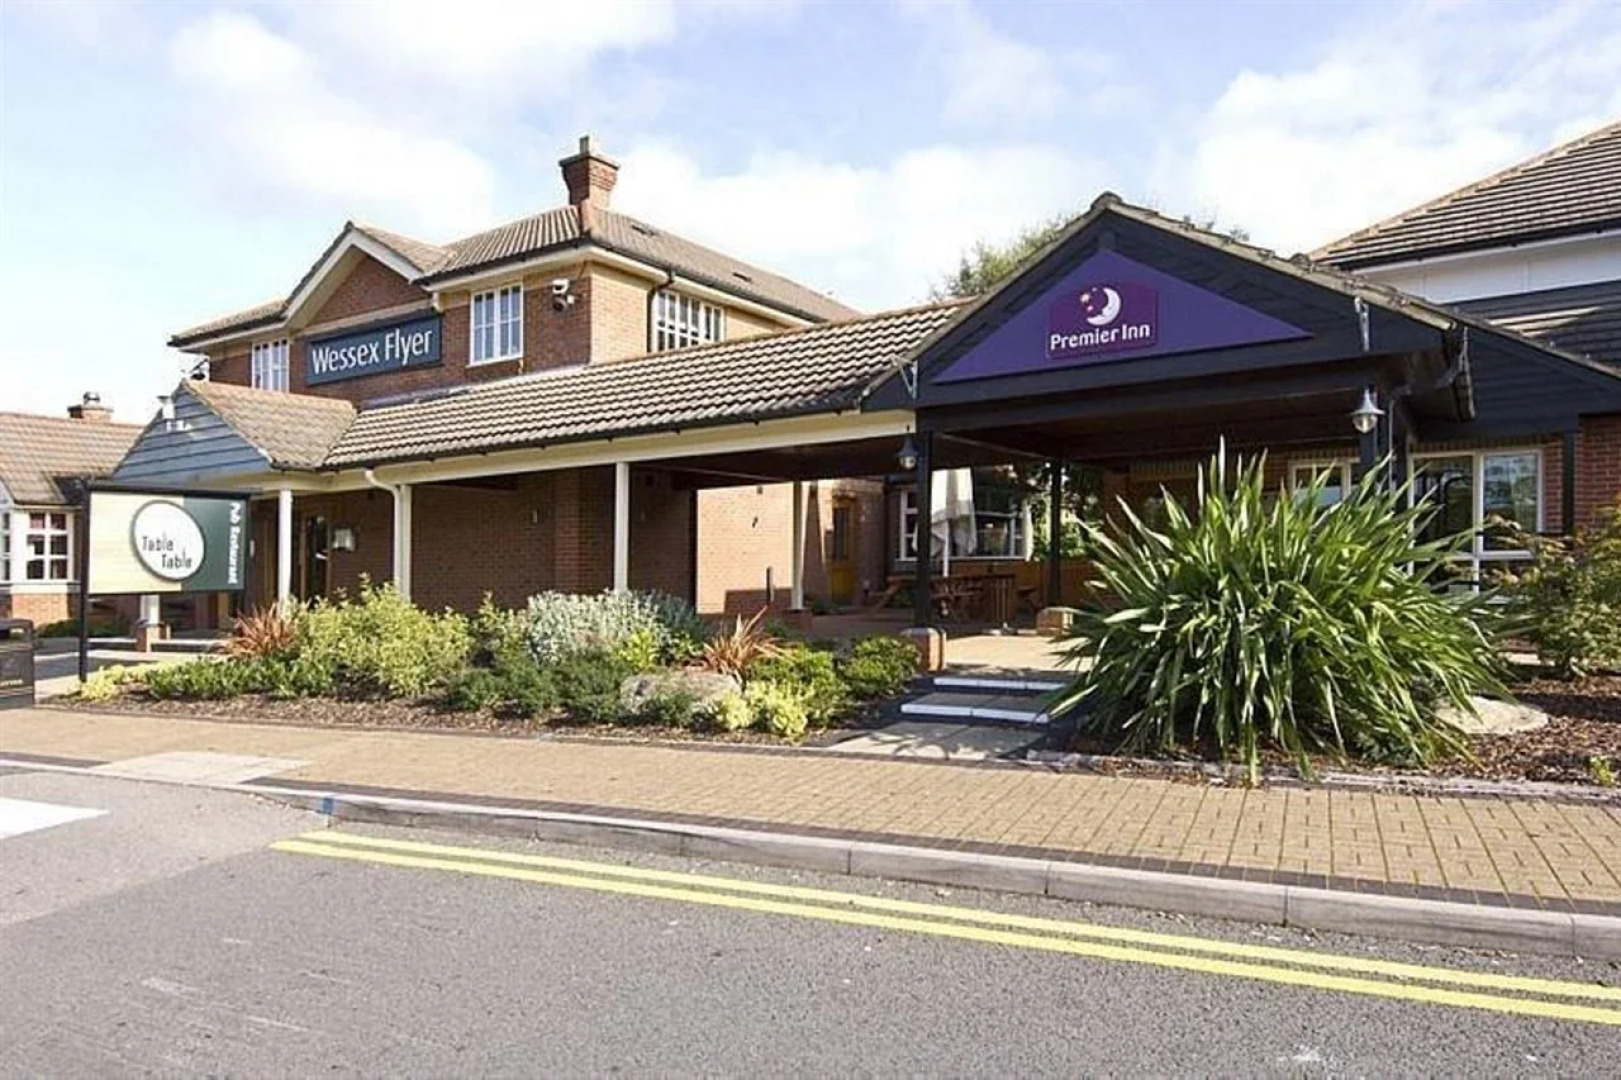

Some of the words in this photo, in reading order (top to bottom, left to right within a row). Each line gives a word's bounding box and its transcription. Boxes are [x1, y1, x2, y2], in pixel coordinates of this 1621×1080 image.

[1050, 328, 1119, 351] Premier
[1122, 324, 1151, 340] Inn
[312, 341, 380, 374] Wessex
[385, 328, 433, 366] Flyer
[142, 531, 174, 552] Table
[161, 547, 192, 569] Table
